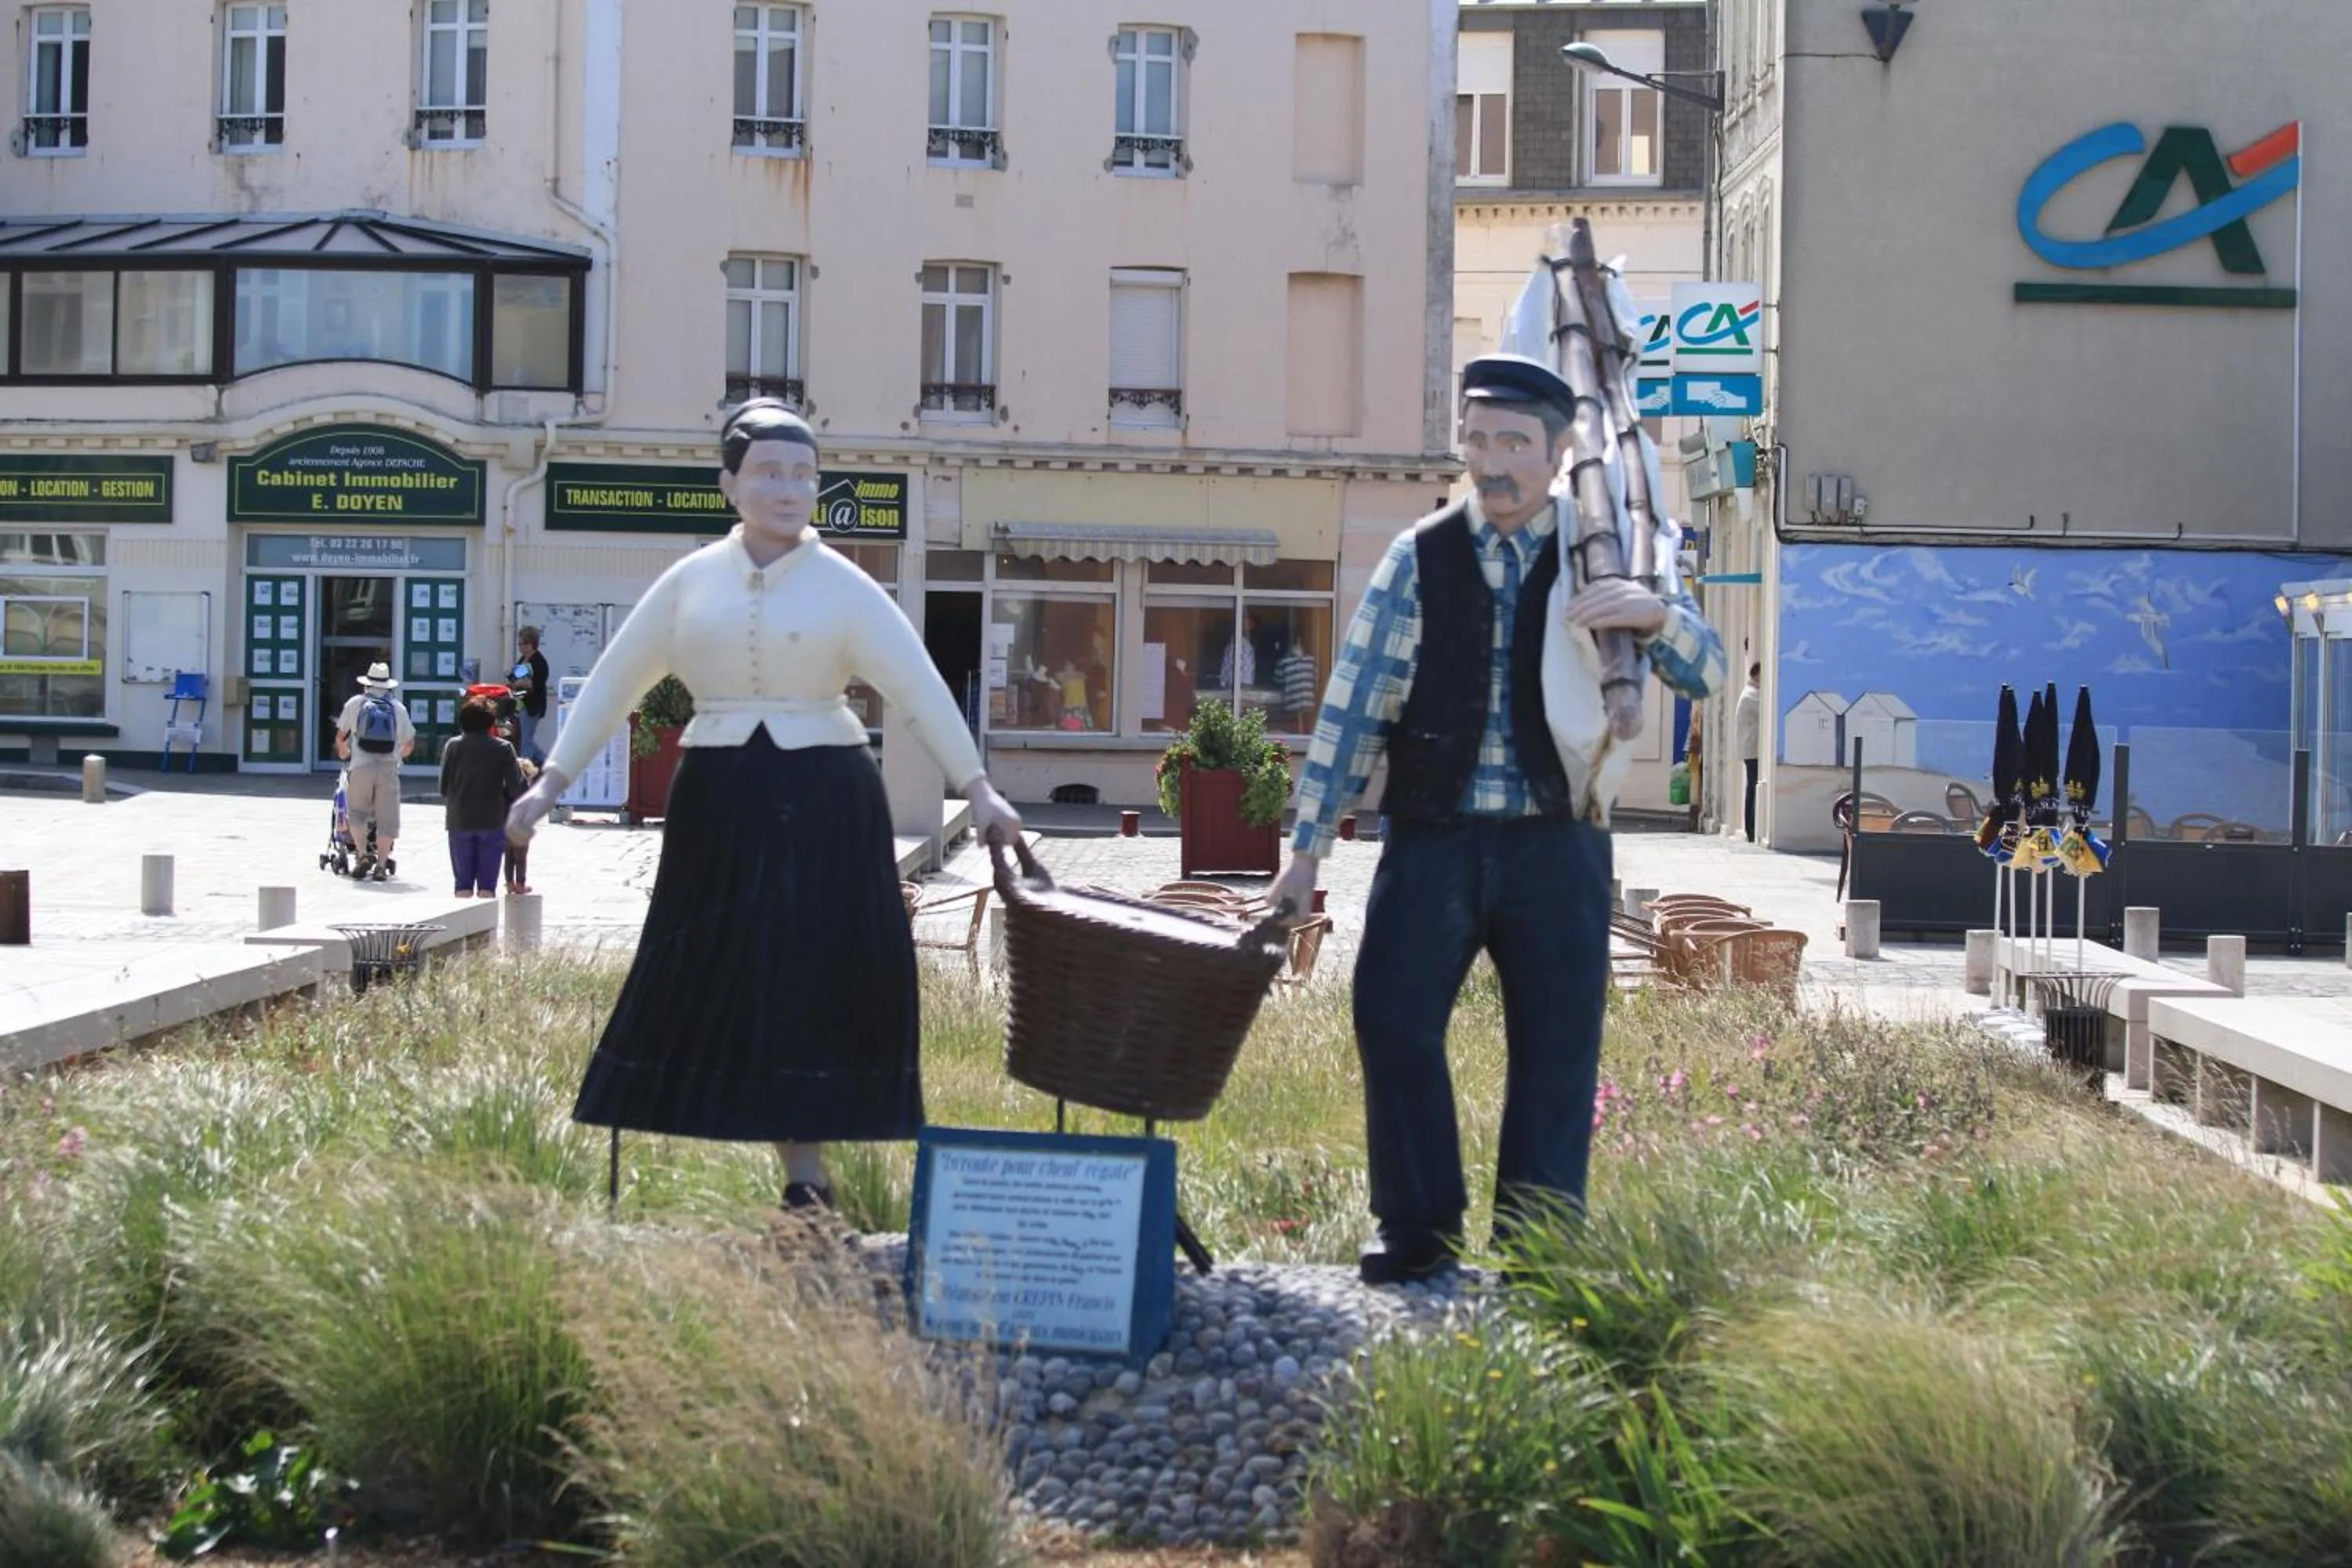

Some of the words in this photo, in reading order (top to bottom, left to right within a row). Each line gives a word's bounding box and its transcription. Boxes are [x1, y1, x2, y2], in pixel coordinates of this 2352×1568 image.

[256, 470, 336, 487] Cabinet
[344, 471, 459, 488] Immobilier
[31, 480, 89, 497] LOCATION
[101, 481, 154, 498] GESTION
[312, 494, 329, 509] E.
[336, 495, 403, 510] DOYEN
[566, 488, 653, 507] TRANSACTION
[667, 492, 727, 510] LOCATION
